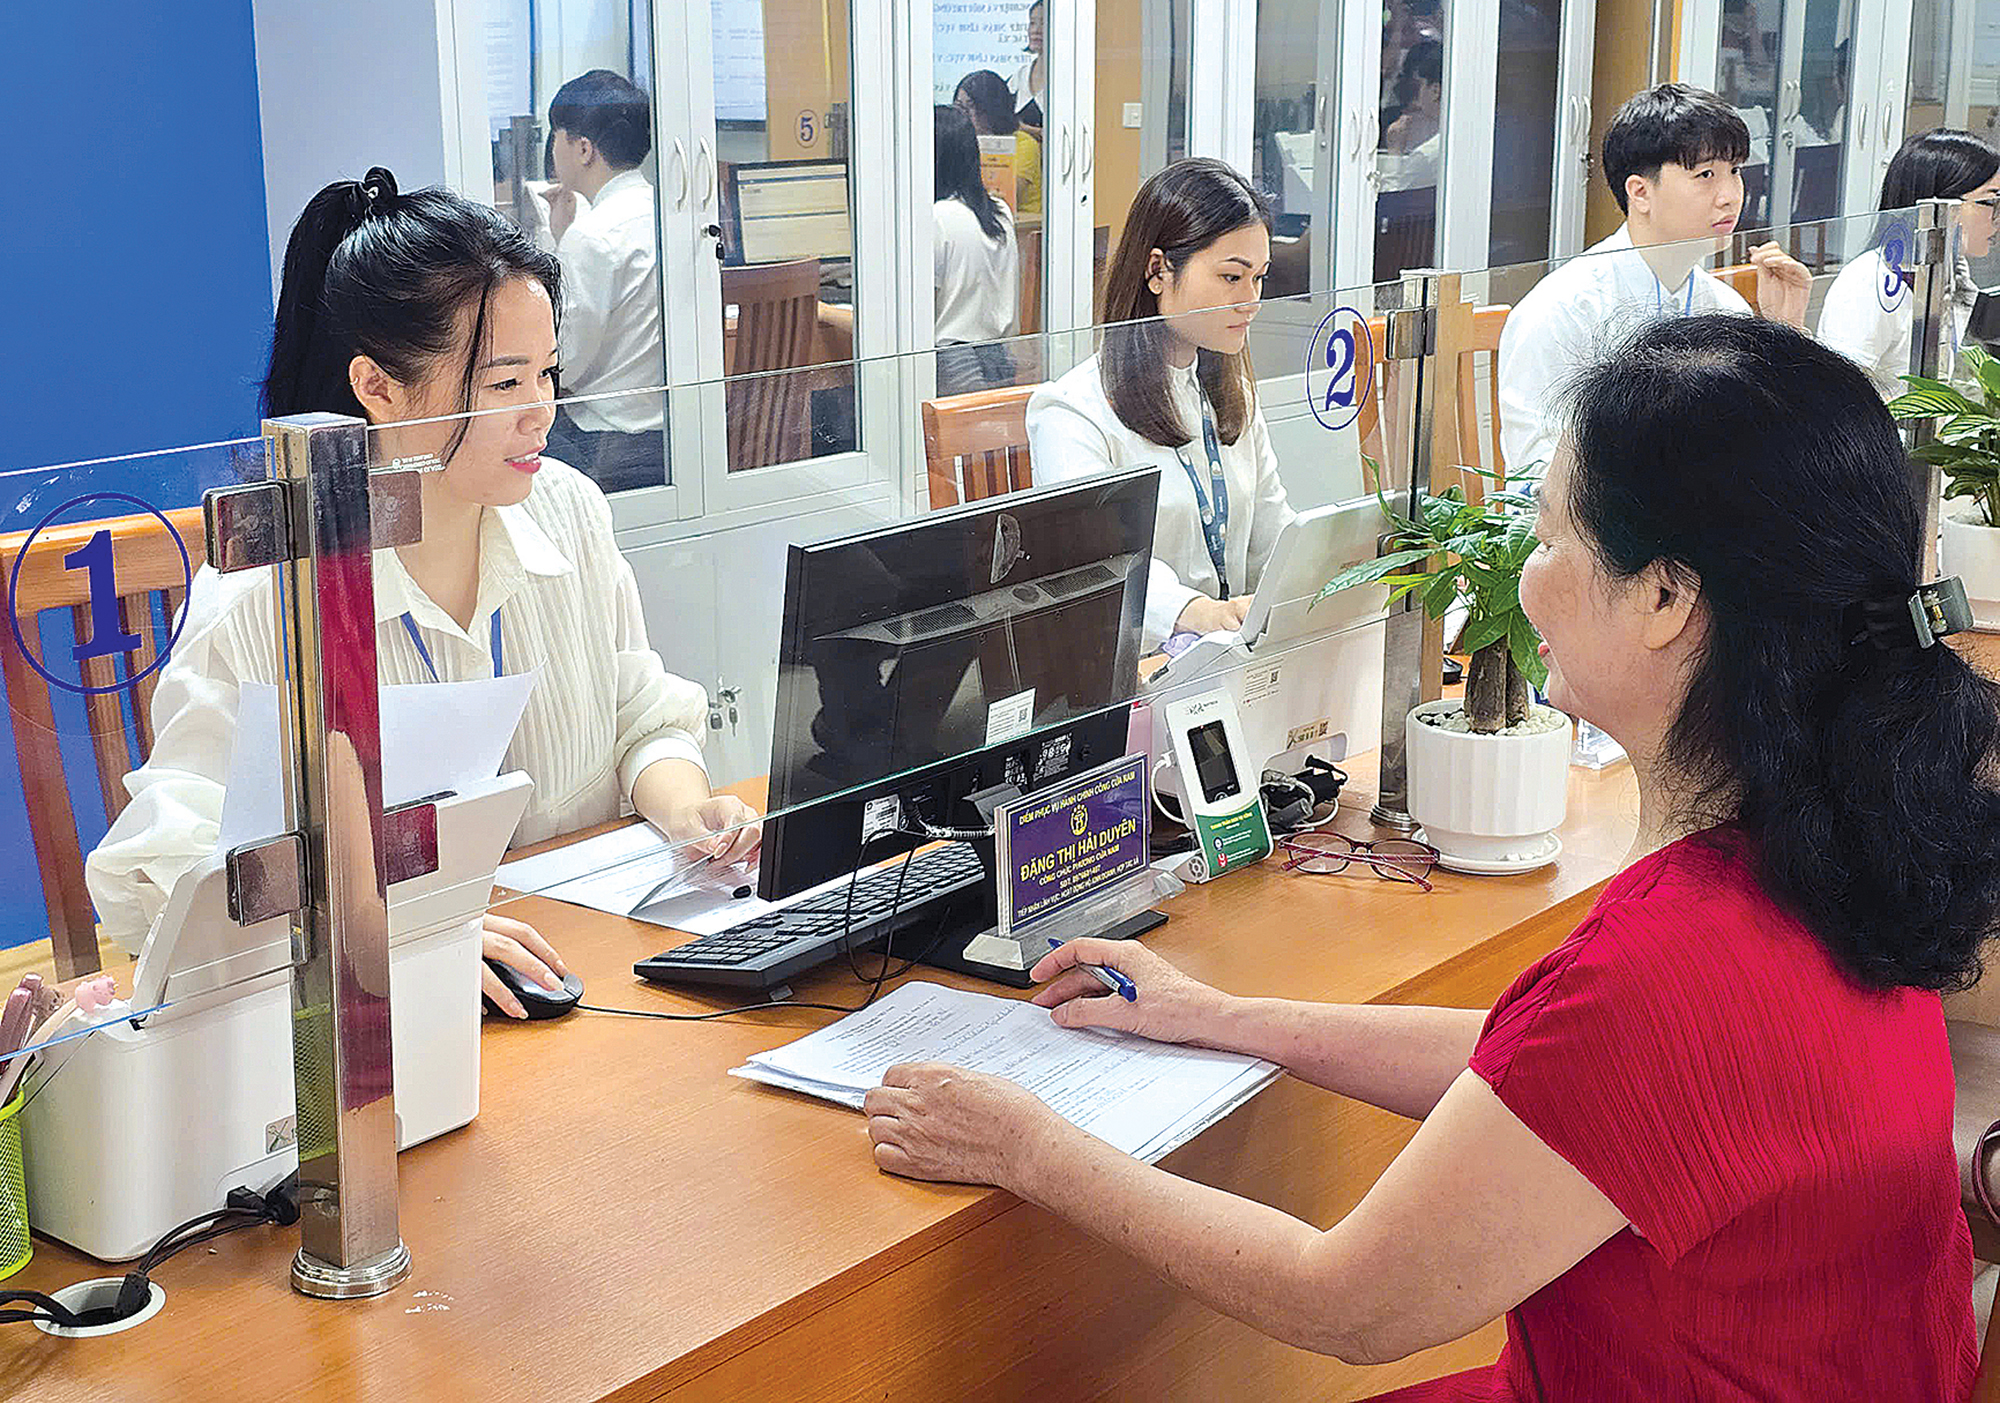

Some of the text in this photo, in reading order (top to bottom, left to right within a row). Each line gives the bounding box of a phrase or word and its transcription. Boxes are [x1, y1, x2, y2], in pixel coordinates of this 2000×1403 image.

[801, 116, 813, 141] 5
[1326, 328, 1356, 411] 2
[63, 529, 142, 660] 1
[1020, 852, 1055, 881] ĐẶNG
[1057, 844, 1076, 863] THỊ
[1077, 831, 1098, 856] HẢI
[1099, 818, 1136, 847] DUYÊN
